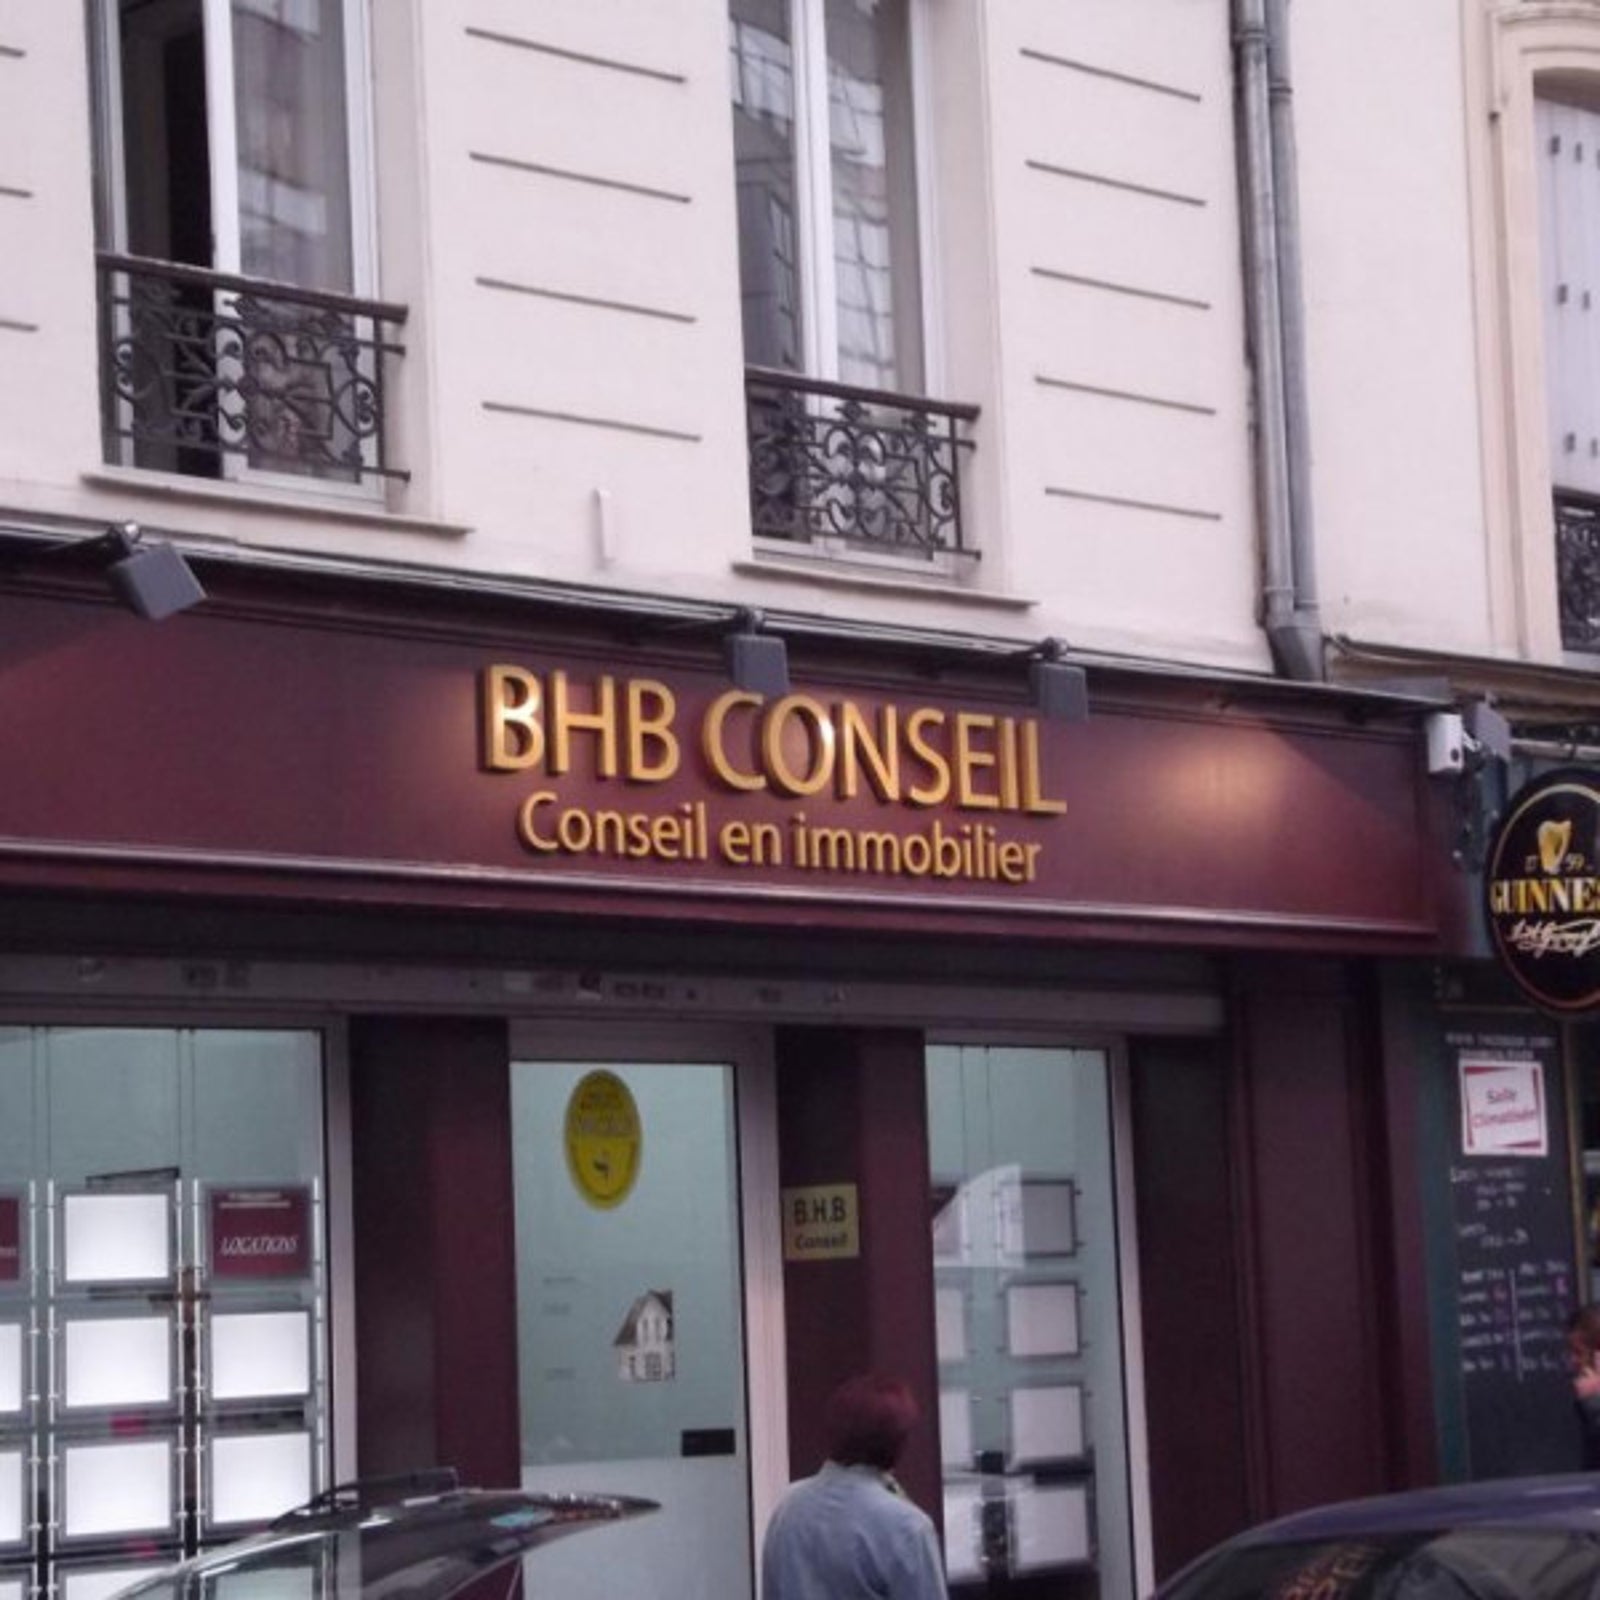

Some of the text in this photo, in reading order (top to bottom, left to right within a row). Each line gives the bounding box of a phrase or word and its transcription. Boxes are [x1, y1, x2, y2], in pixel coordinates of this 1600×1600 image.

[482, 664, 1068, 815] BHB CONSEIL
[519, 791, 1042, 882] Conseil en immobilier
[219, 1235, 299, 1256] LOCATIONS
